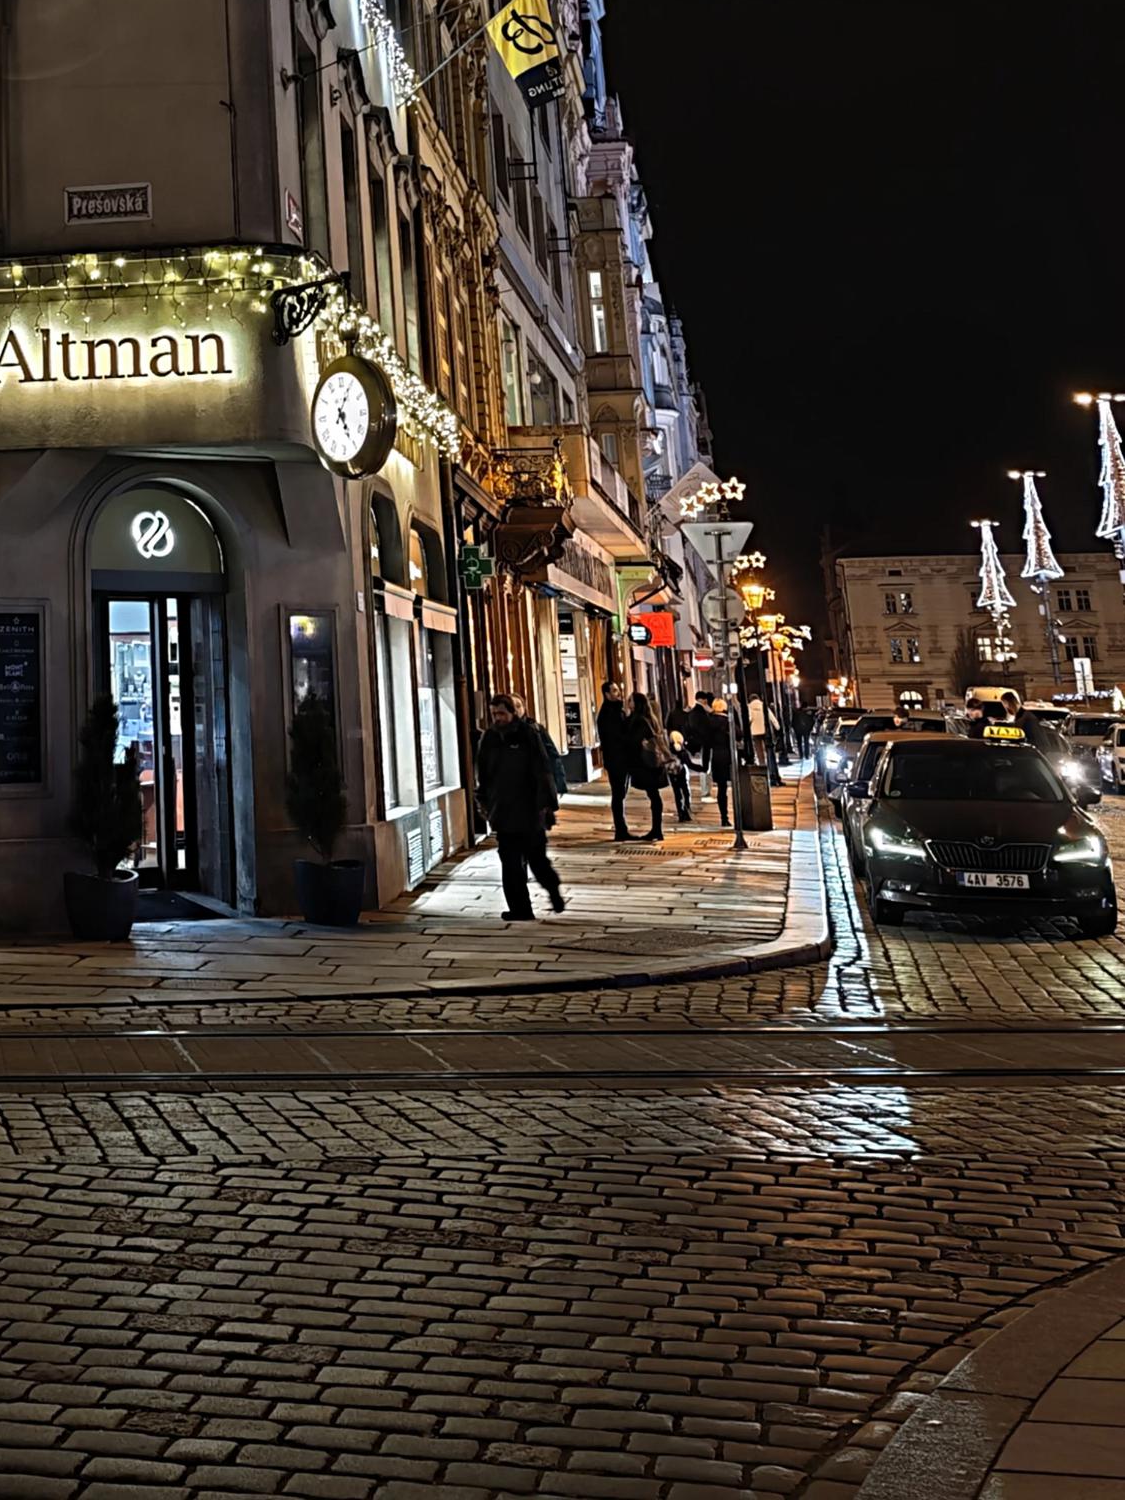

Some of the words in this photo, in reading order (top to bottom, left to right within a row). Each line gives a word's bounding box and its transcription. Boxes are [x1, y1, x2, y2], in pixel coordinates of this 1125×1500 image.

[72, 190, 144, 215] Prešovská
[967, 874, 987, 886] 4AV
[995, 875, 1024, 887] 3576
